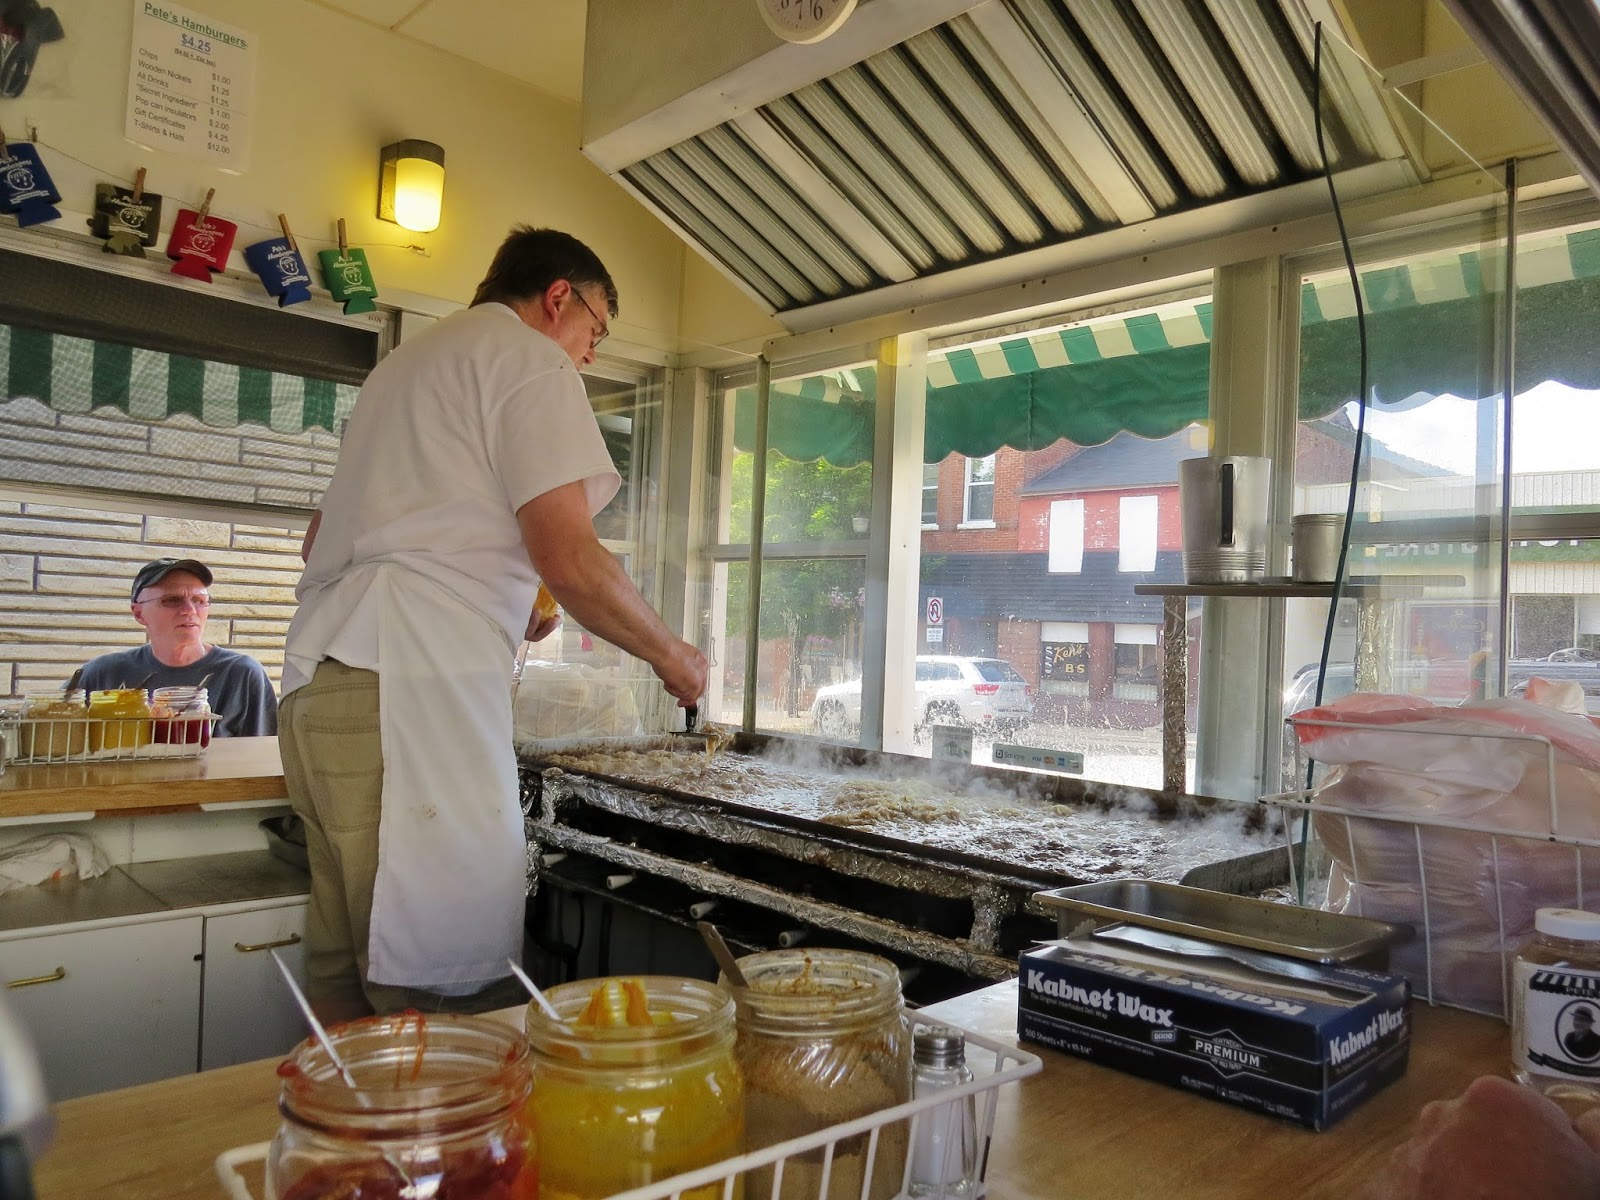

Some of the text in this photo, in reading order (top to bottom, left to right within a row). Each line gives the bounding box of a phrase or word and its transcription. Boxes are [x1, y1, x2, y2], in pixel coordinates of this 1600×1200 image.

[144, 2, 247, 48] Pete's Hamburgers
[181, 33, 211, 53] $4.25
[138, 48, 159, 61] Chips
[137, 71, 169, 88] All Drinks
[138, 59, 192, 84] Wooden Nickels
[212, 73, 231, 85] $1.00
[211, 84, 230, 97] $1.25
[135, 95, 149, 107] Pop
[150, 101, 163, 111] can
[210, 95, 230, 108] $1.25
[134, 107, 186, 130] Gift Certificates
[134, 119, 185, 142] T-Shirts & Hats
[207, 142, 230, 155] $12.00
[1053, 644, 1085, 665] Ken's
[1027, 968, 1174, 1027] Kabnet Wax
[1025, 1028, 1036, 1039] 500
[1036, 1032, 1057, 1046] Sheets
[1329, 1015, 1379, 1067] Kabnet
[1378, 1007, 1404, 1037] Wax
[1195, 1040, 1261, 1068] PREMIUM
